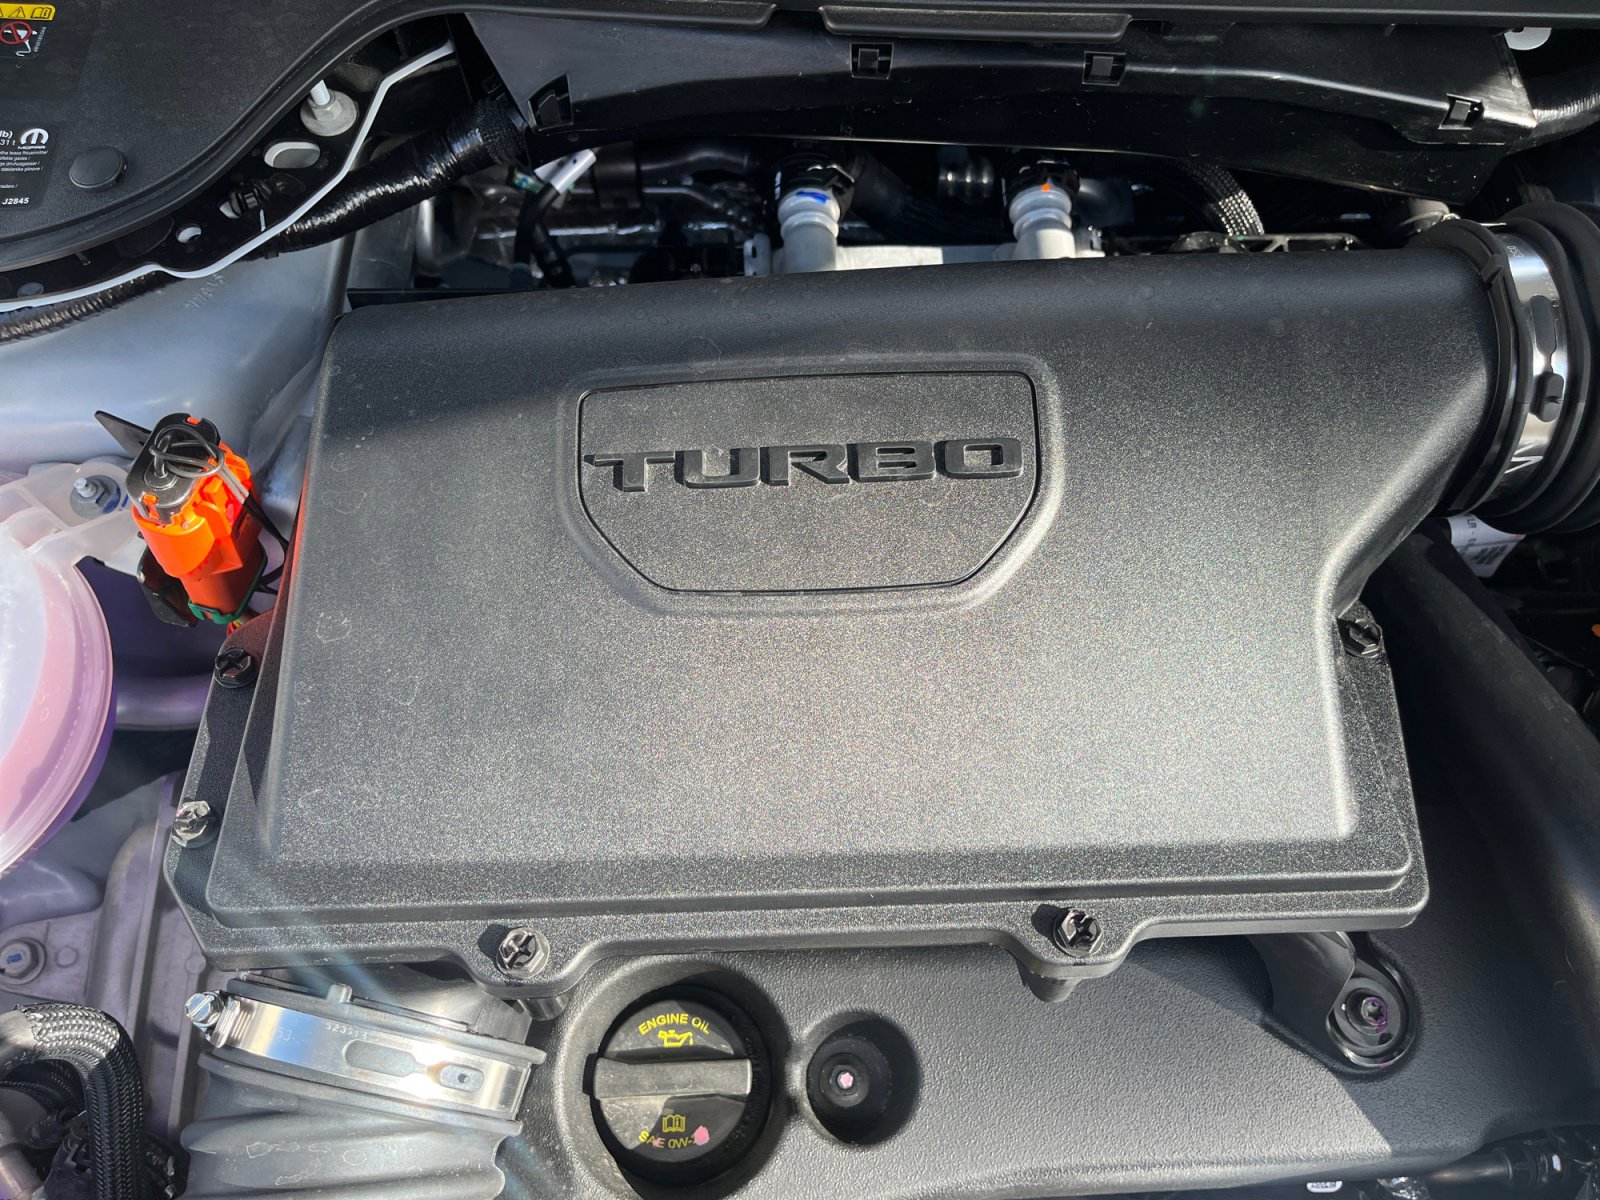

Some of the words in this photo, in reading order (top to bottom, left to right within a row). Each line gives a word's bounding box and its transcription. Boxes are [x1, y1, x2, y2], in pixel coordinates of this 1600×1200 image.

[1, 197, 30, 205] J2845
[584, 437, 1024, 493] TURBO
[638, 1013, 689, 1036] ENGINE
[691, 1016, 712, 1035] OIL
[638, 1129, 666, 1149] SAE
